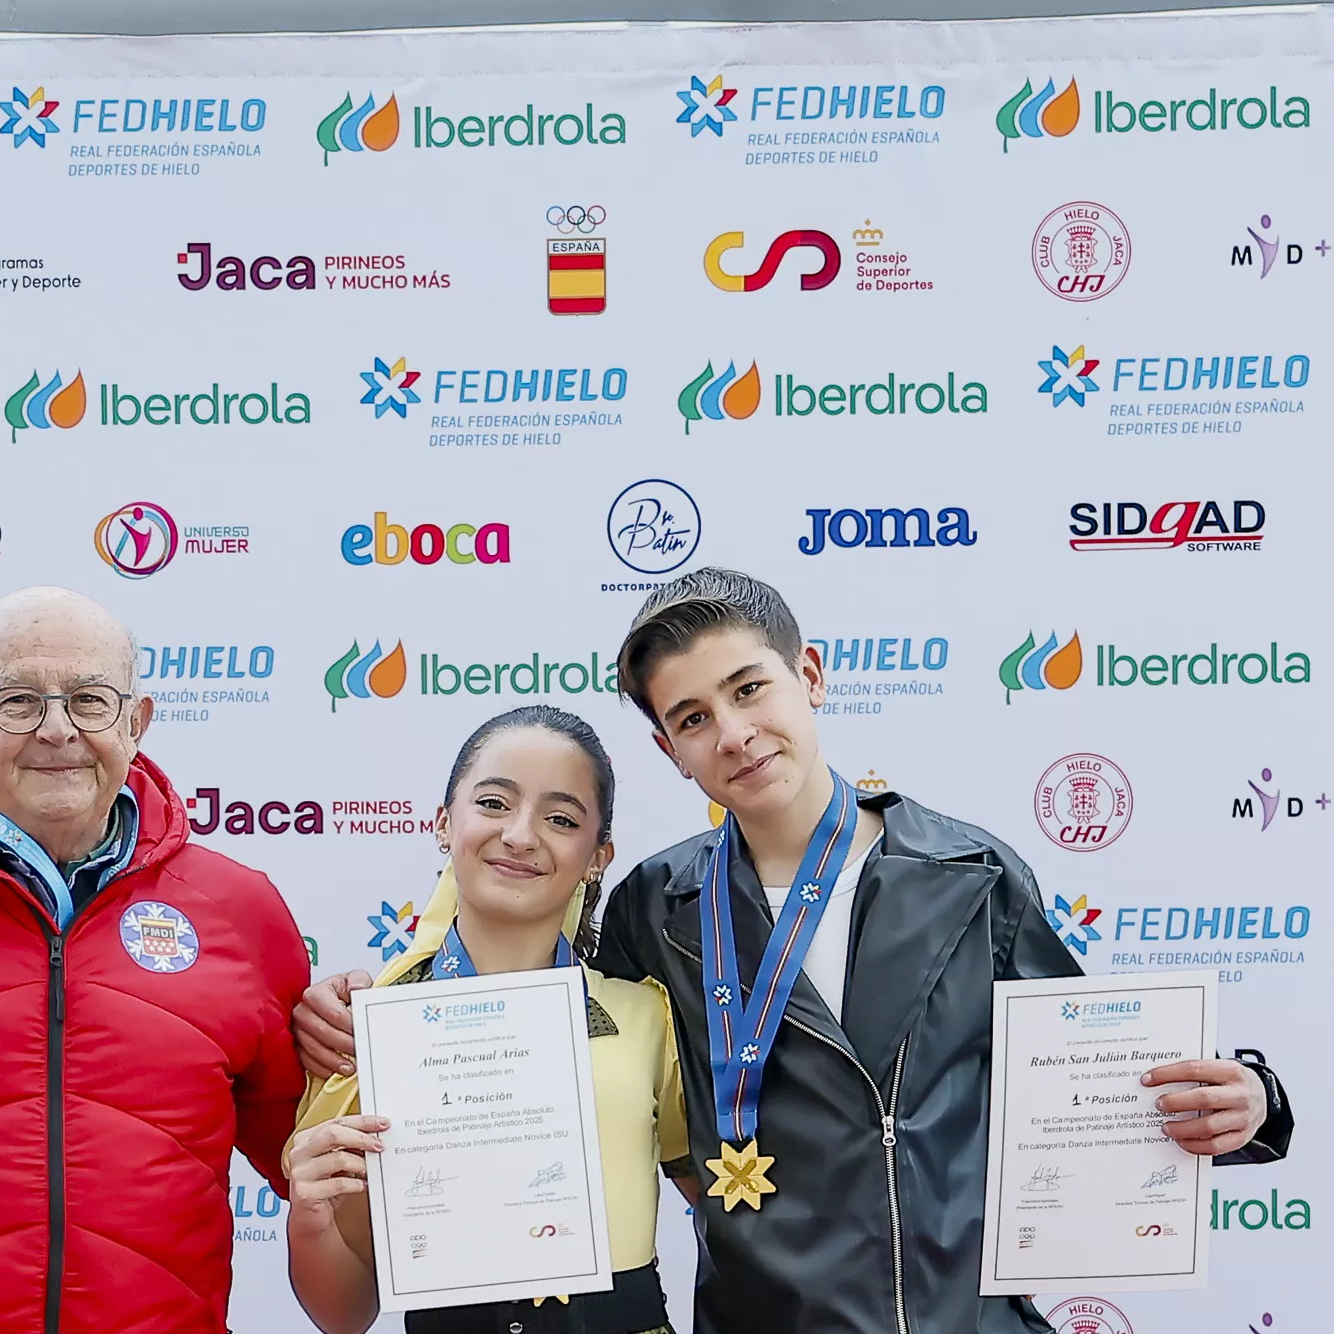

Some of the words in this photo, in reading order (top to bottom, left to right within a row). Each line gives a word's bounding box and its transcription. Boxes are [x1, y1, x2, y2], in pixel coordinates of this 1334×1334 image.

[552, 241, 601, 253] ESPAÑA
[177, 243, 315, 291] Jaca
[325, 255, 405, 269] PIRINEOS
[12, 279, 18, 292] y
[23, 275, 81, 291] Deporte
[326, 276, 336, 289] Y
[343, 275, 407, 289] MUCHO
[413, 270, 450, 288] MÁS
[185, 527, 248, 537] UNIVERSO
[186, 539, 248, 553] MUJER
[1098, 642, 1310, 686] Iberdrola
[1115, 906, 1310, 940] FEDHIELO
[143, 927, 174, 938] FMDI
[1112, 953, 1144, 965] REAL
[1149, 950, 1232, 964] FEDERACIÓN
[1236, 949, 1304, 963] ESPAÑOLA
[445, 1001, 506, 1018] FEDHIELO
[1083, 1002, 1141, 1015] FEDHIELO
[419, 1056, 450, 1069] Alma
[453, 1051, 497, 1065] Pascual
[500, 1048, 530, 1060] Arias
[1031, 1055, 1066, 1067] Rubén
[1068, 1054, 1090, 1065] San
[1092, 1051, 1128, 1064] Julián
[1131, 1050, 1182, 1063] Barquero
[438, 1074, 449, 1082] Se
[451, 1072, 462, 1080] ha
[463, 1069, 502, 1080] clasificado
[1070, 1073, 1080, 1081] Se
[1093, 1070, 1130, 1079] clasificado
[441, 1092, 453, 1106] 1
[465, 1092, 513, 1104] Posición
[1072, 1094, 1082, 1106] 1
[1091, 1094, 1138, 1105] Posición
[405, 1120, 416, 1128] En
[417, 1119, 424, 1127] el
[425, 1114, 479, 1127] Campeonato
[479, 1113, 489, 1121] de
[491, 1109, 521, 1122] España
[522, 1106, 555, 1117] Absoluto
[1052, 1115, 1102, 1127] Campeonato
[1103, 1113, 1113, 1121] de
[1114, 1111, 1144, 1123] España
[418, 1125, 450, 1136] Iberdrola
[451, 1125, 461, 1133] de
[462, 1121, 493, 1133] Patinaje
[494, 1118, 523, 1130] Artístico
[525, 1117, 544, 1126] 2025
[1043, 1126, 1074, 1134] Iberdrola
[1086, 1122, 1115, 1133] Patinaje
[1116, 1120, 1145, 1129] Artístico
[395, 1147, 406, 1155] En
[407, 1140, 444, 1155] categoría
[446, 1140, 472, 1150] Danza
[473, 1135, 523, 1148] Intermediate
[524, 1133, 552, 1143] Novice
[553, 1131, 569, 1139] ISU
[1018, 1143, 1029, 1151] En
[1030, 1142, 1066, 1152] categoría
[1068, 1140, 1093, 1148] Danza
[1095, 1138, 1142, 1146] Intermediate
[1144, 1135, 1170, 1144] Novice
